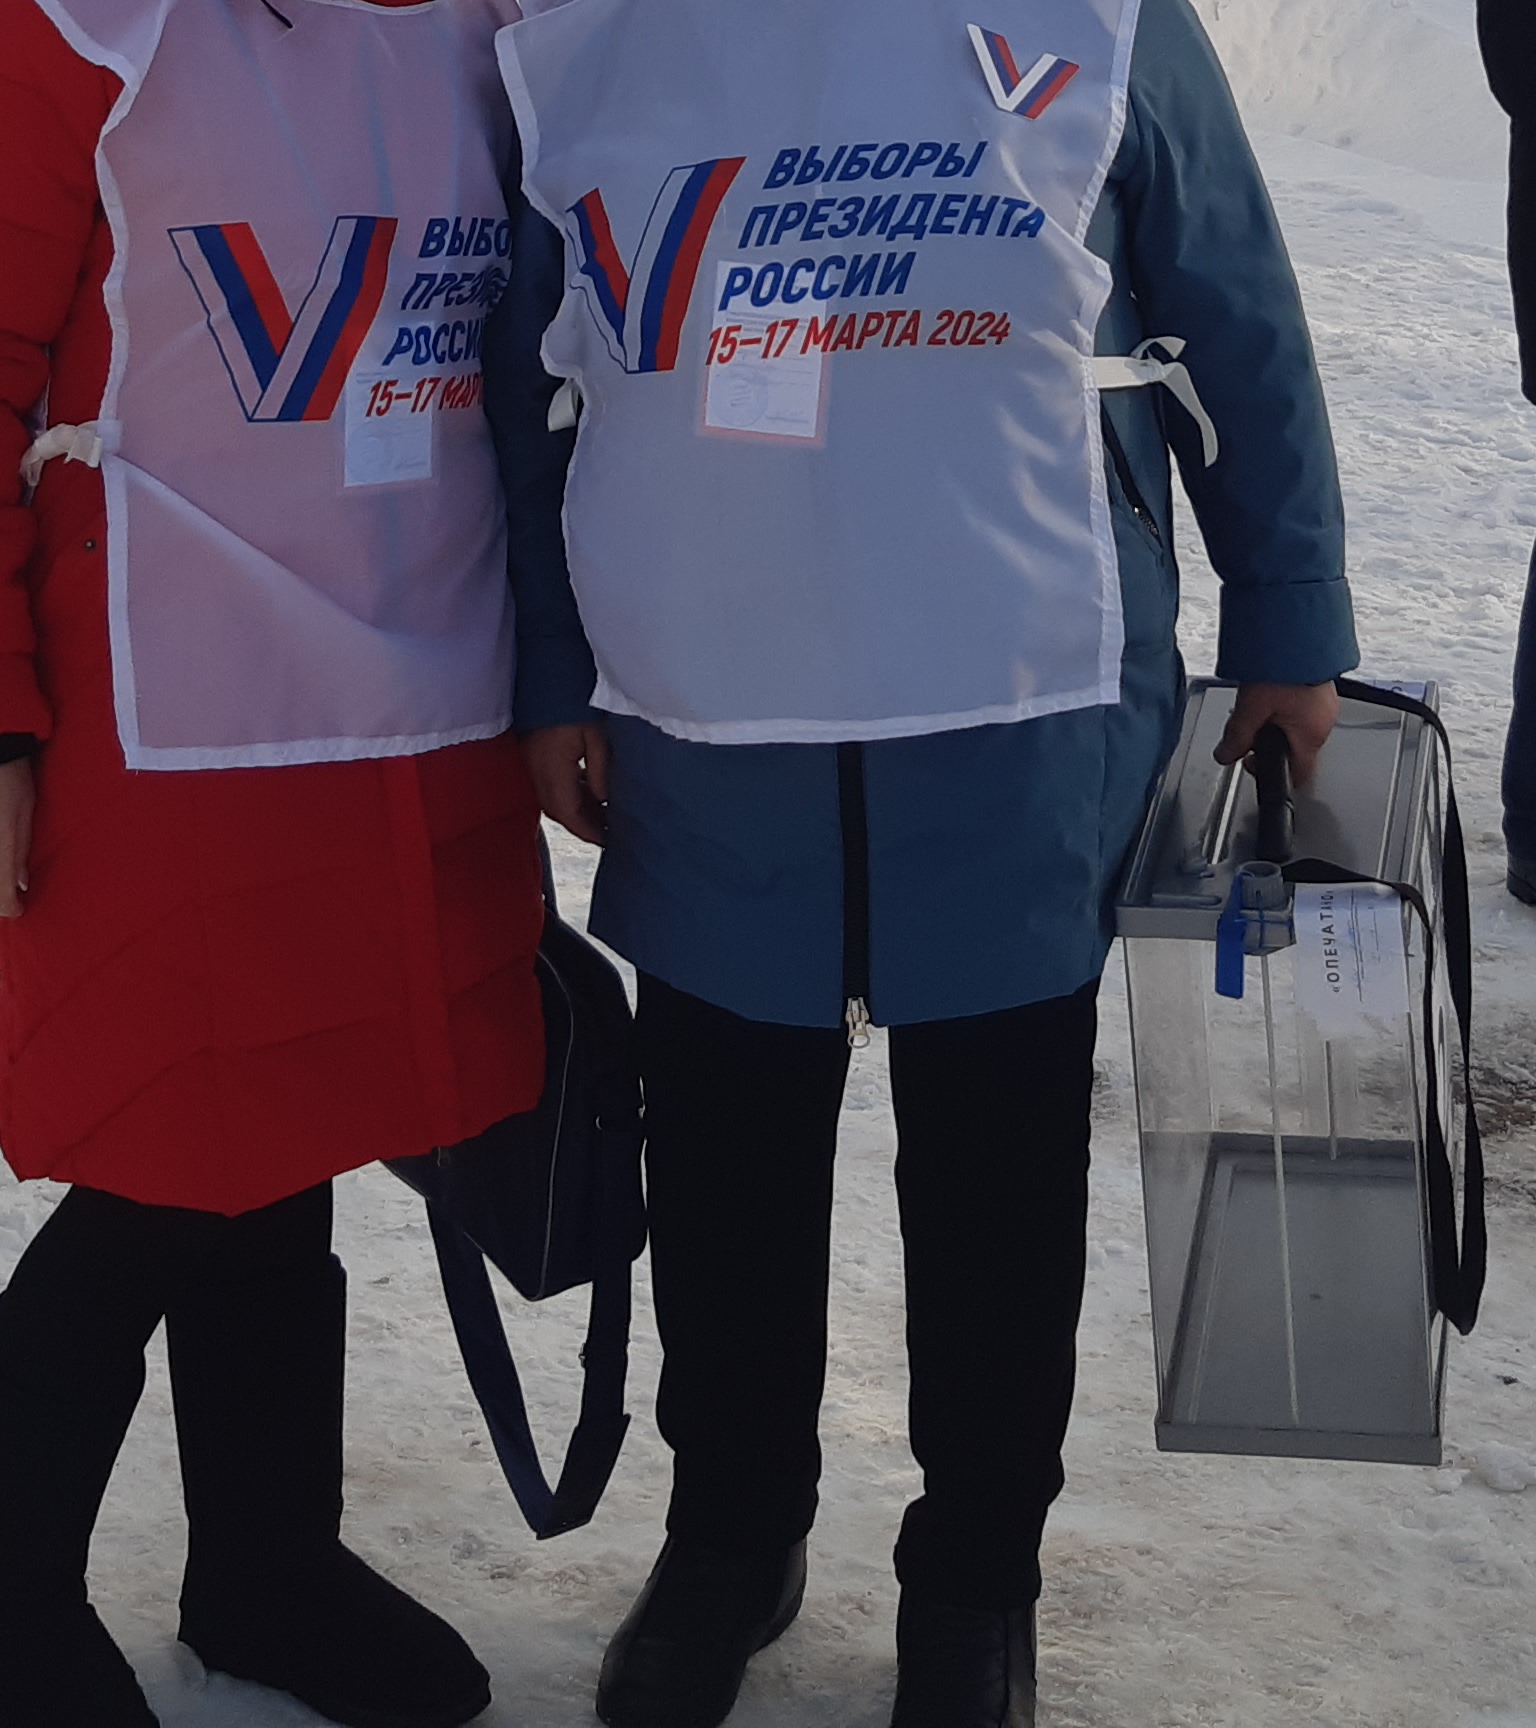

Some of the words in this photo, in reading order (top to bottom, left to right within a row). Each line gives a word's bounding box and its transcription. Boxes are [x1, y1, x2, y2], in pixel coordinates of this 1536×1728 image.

[763, 141, 987, 190] ВЫБОРЫ
[418, 216, 512, 260] ВЫБО
[738, 193, 1046, 249] ПРЕЗИДЕНТА
[718, 252, 916, 311] РОССИИ
[382, 319, 484, 366] РОССИ
[799, 309, 921, 355] МАРТА
[926, 310, 1011, 348] 2024
[438, 372, 483, 411] МАР
